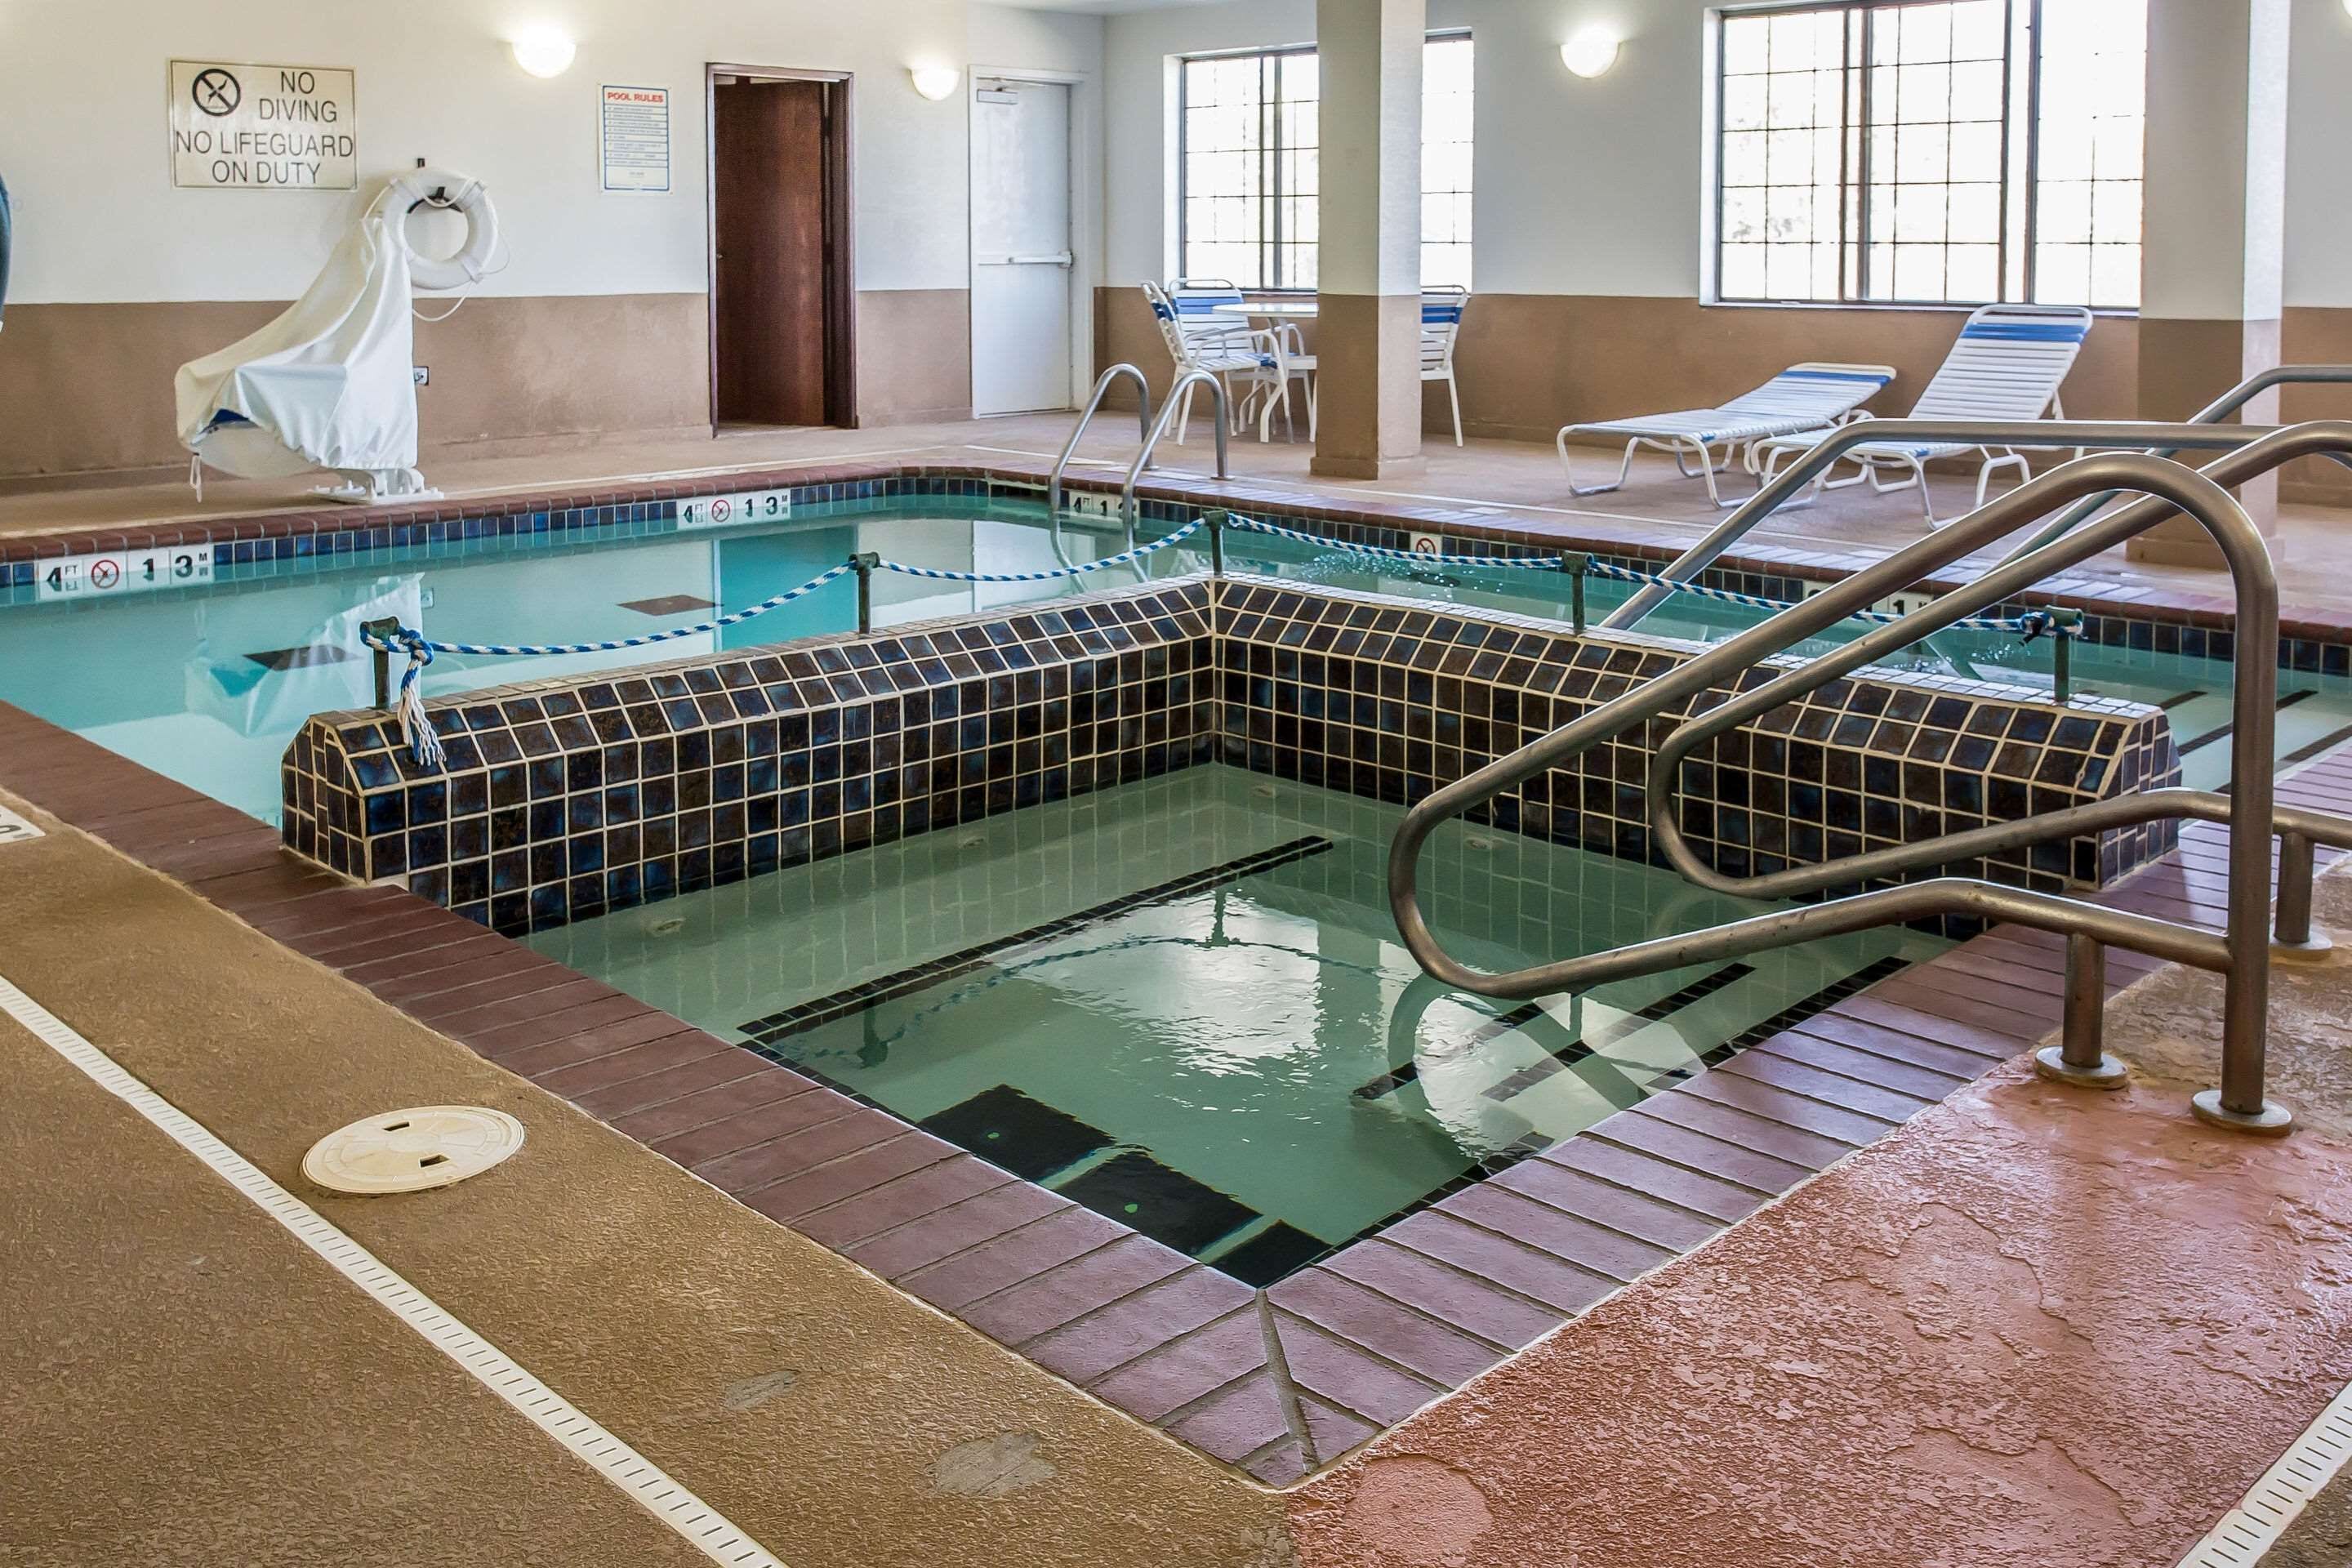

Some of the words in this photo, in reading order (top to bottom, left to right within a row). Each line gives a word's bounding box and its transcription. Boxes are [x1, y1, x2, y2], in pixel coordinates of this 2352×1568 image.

[280, 71, 315, 94] NO
[607, 91, 632, 101] POOL
[634, 93, 664, 103] RULES
[259, 98, 337, 122] DIVING
[176, 131, 212, 154] NO
[220, 131, 354, 158] LIFEGUARD
[212, 160, 247, 183] ON
[256, 161, 321, 184] DUTY
[695, 503, 704, 511] FT
[65, 564, 78, 576] FT
[198, 552, 208, 562] M
